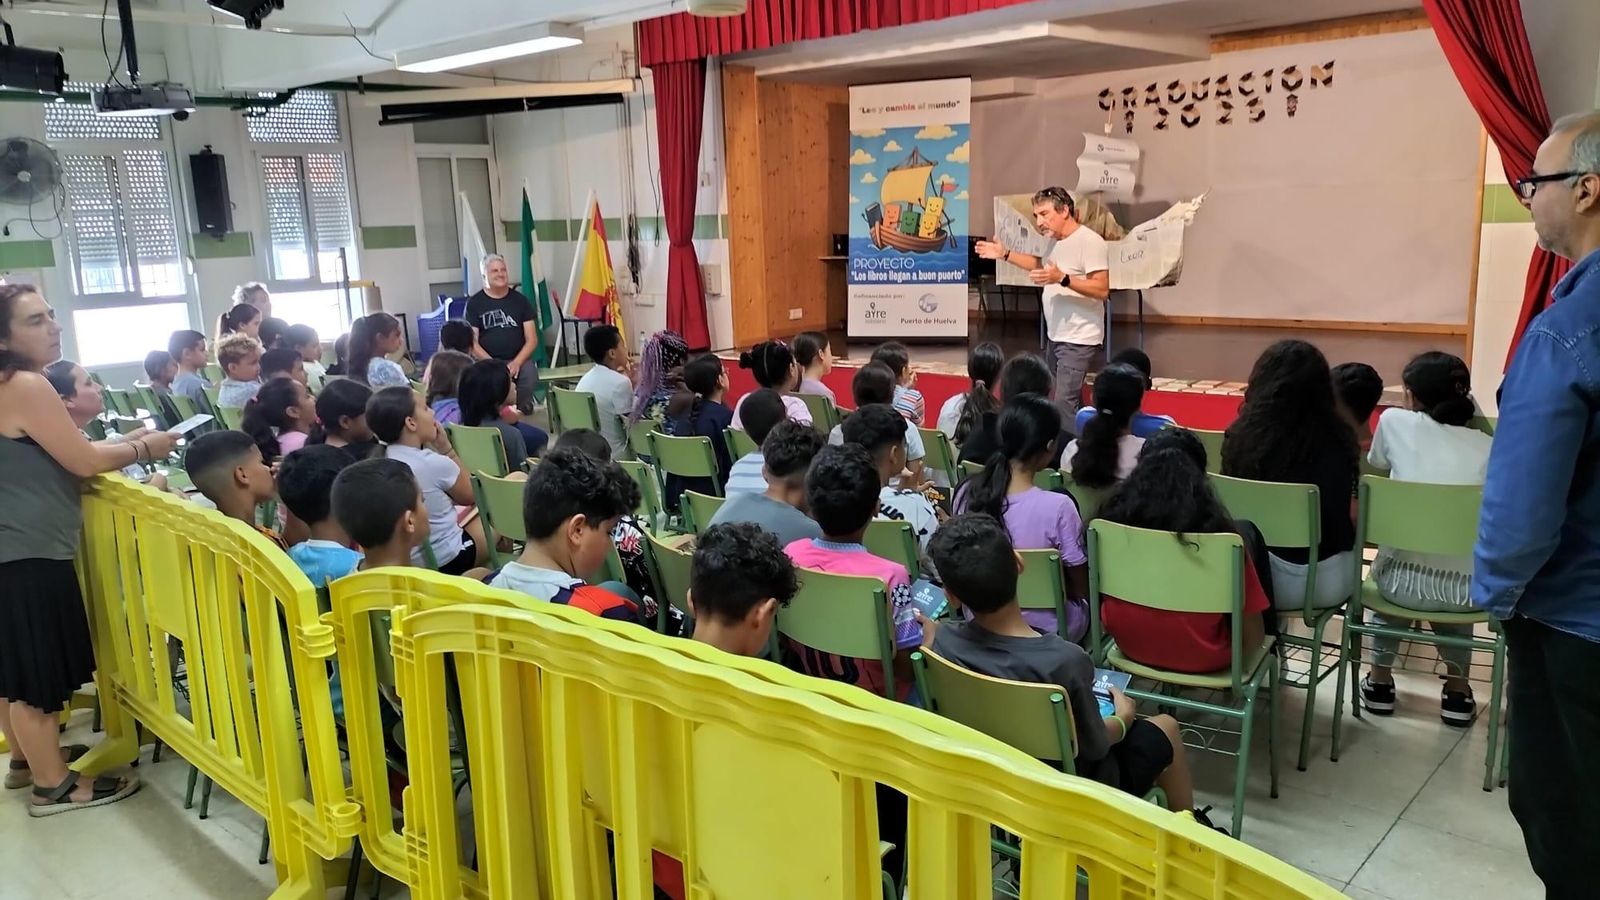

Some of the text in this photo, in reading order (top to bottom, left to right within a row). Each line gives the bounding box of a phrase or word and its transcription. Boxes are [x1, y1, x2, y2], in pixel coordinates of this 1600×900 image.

[1153, 97, 1266, 131] 2025
[854, 258, 915, 269] PROYECTO
[851, 270, 866, 281] "Los
[868, 270, 887, 281] libros
[912, 273, 917, 281] a
